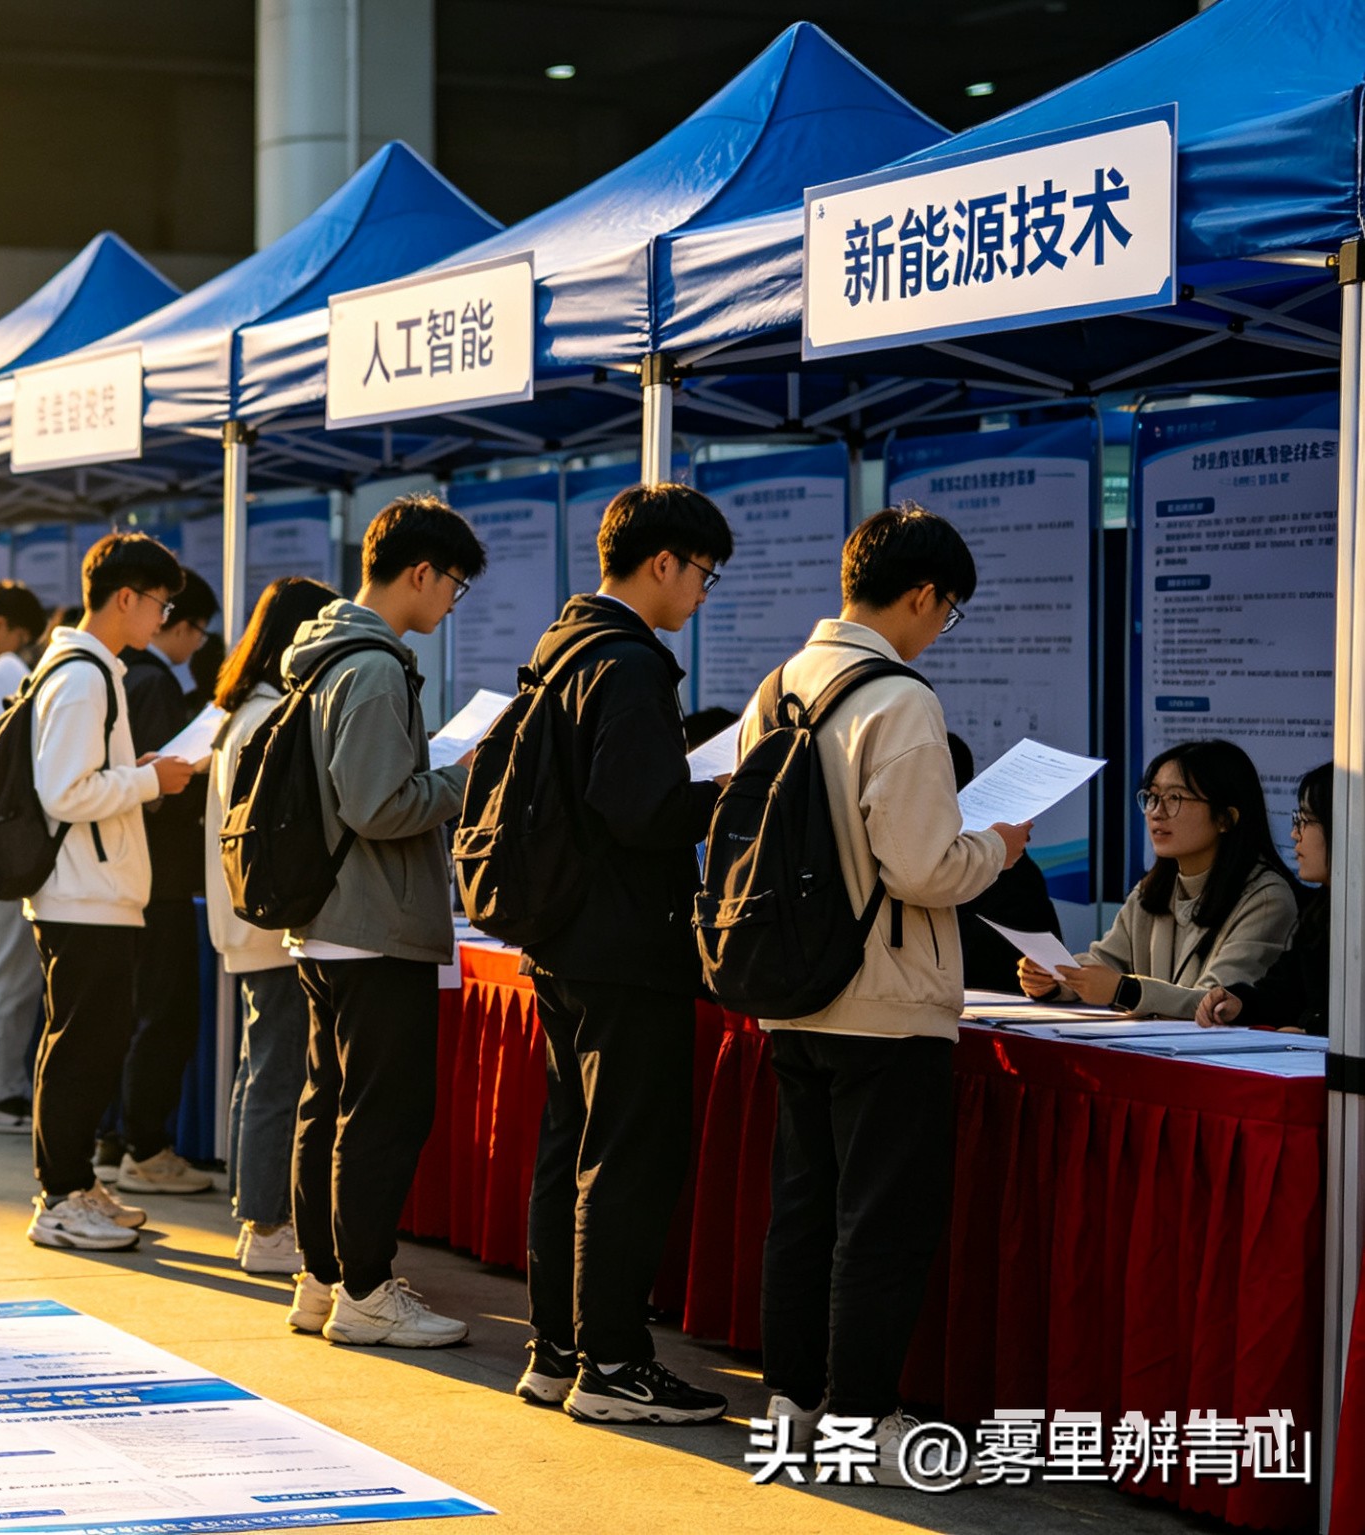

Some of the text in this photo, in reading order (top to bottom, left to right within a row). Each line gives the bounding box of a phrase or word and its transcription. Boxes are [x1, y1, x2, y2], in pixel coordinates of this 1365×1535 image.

[843, 167, 1133, 306] 新能源技术
[362, 298, 495, 387] 人工智能
